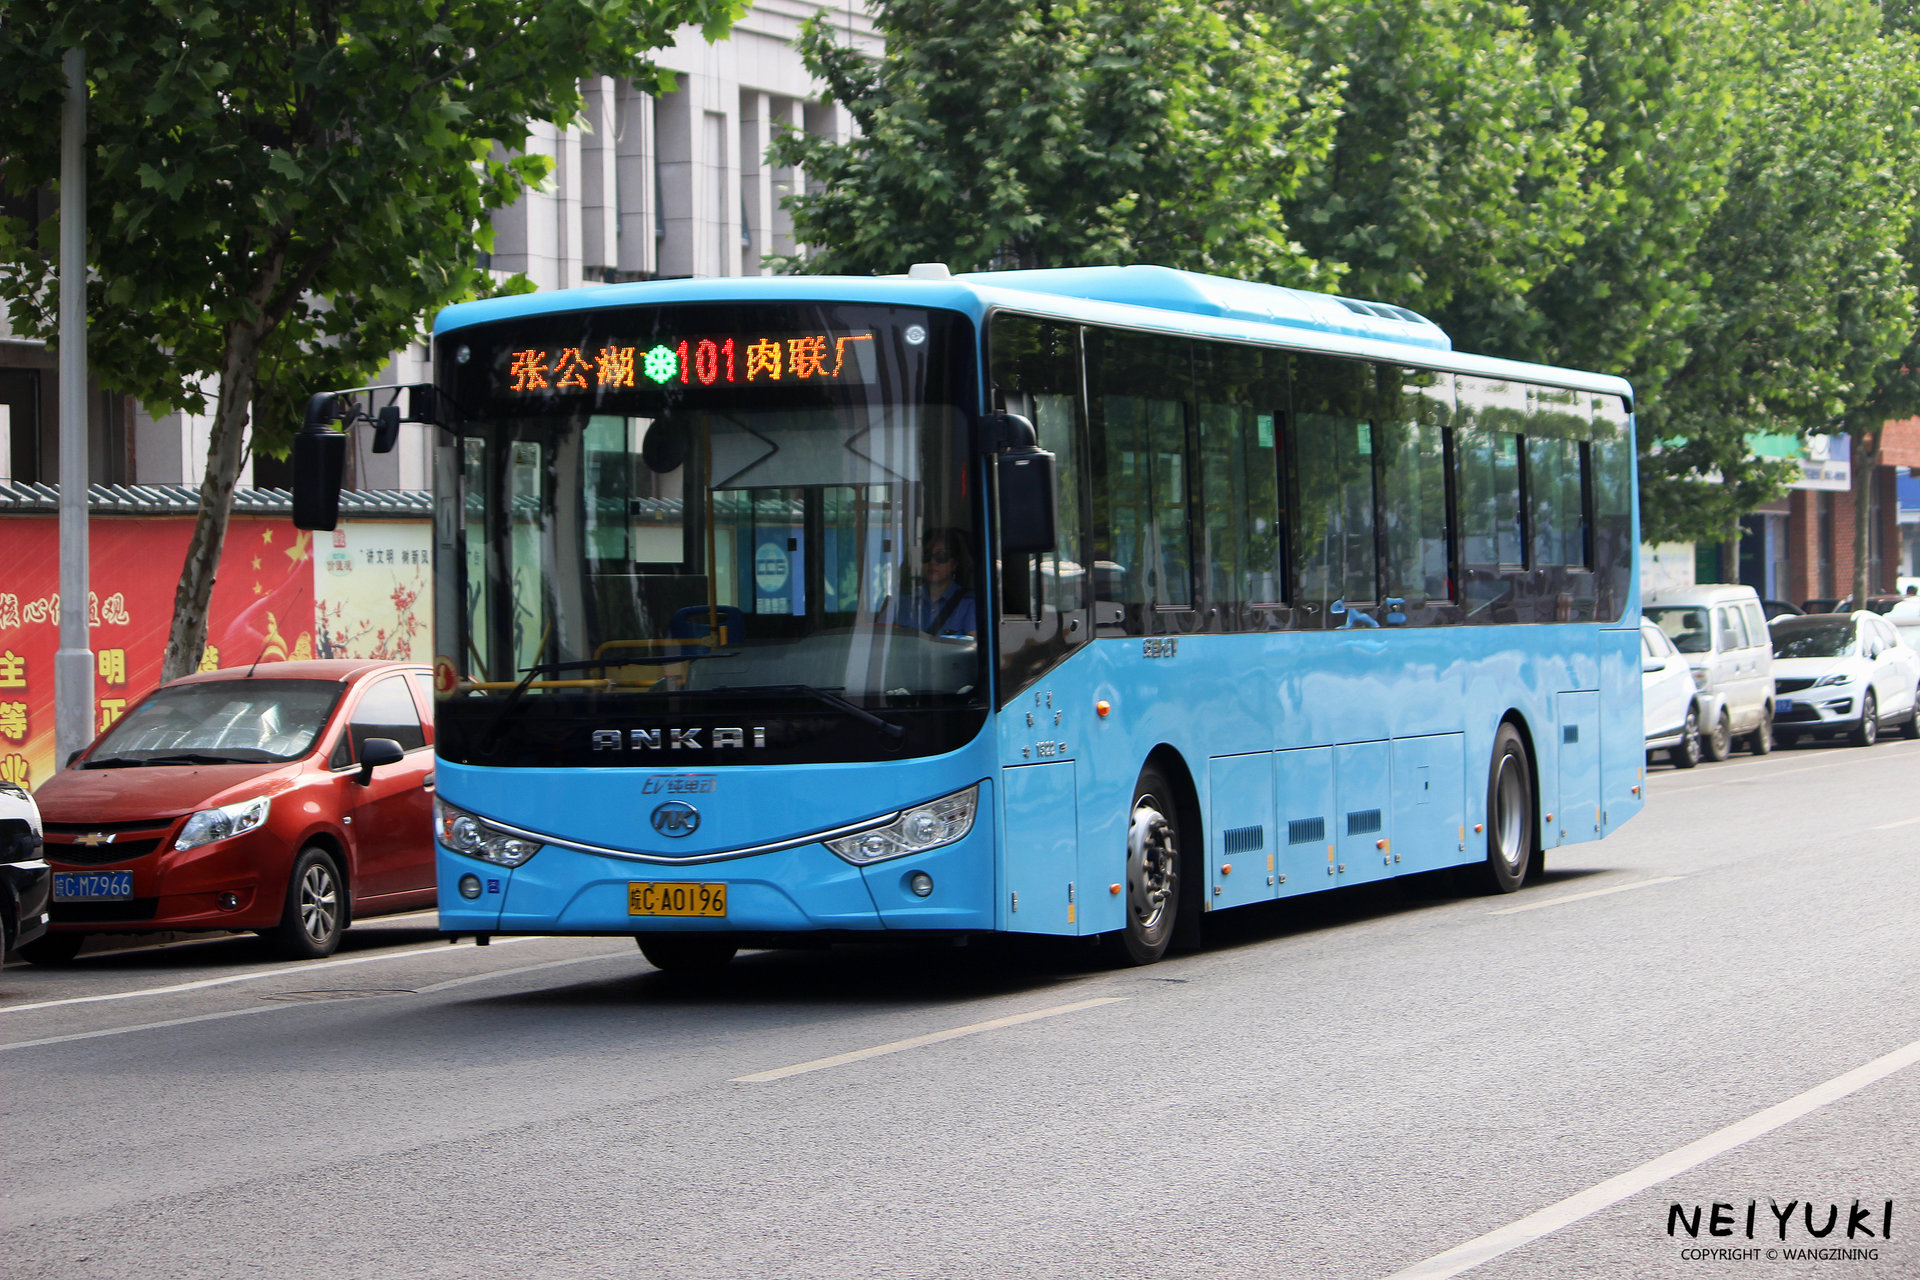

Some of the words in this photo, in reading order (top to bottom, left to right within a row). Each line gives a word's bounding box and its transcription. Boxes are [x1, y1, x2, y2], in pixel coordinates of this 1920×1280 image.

[510, 346, 634, 391] 张公湖
[677, 338, 735, 385] 101
[746, 334, 873, 381] 肉联厂
[98, 648, 125, 685] 明
